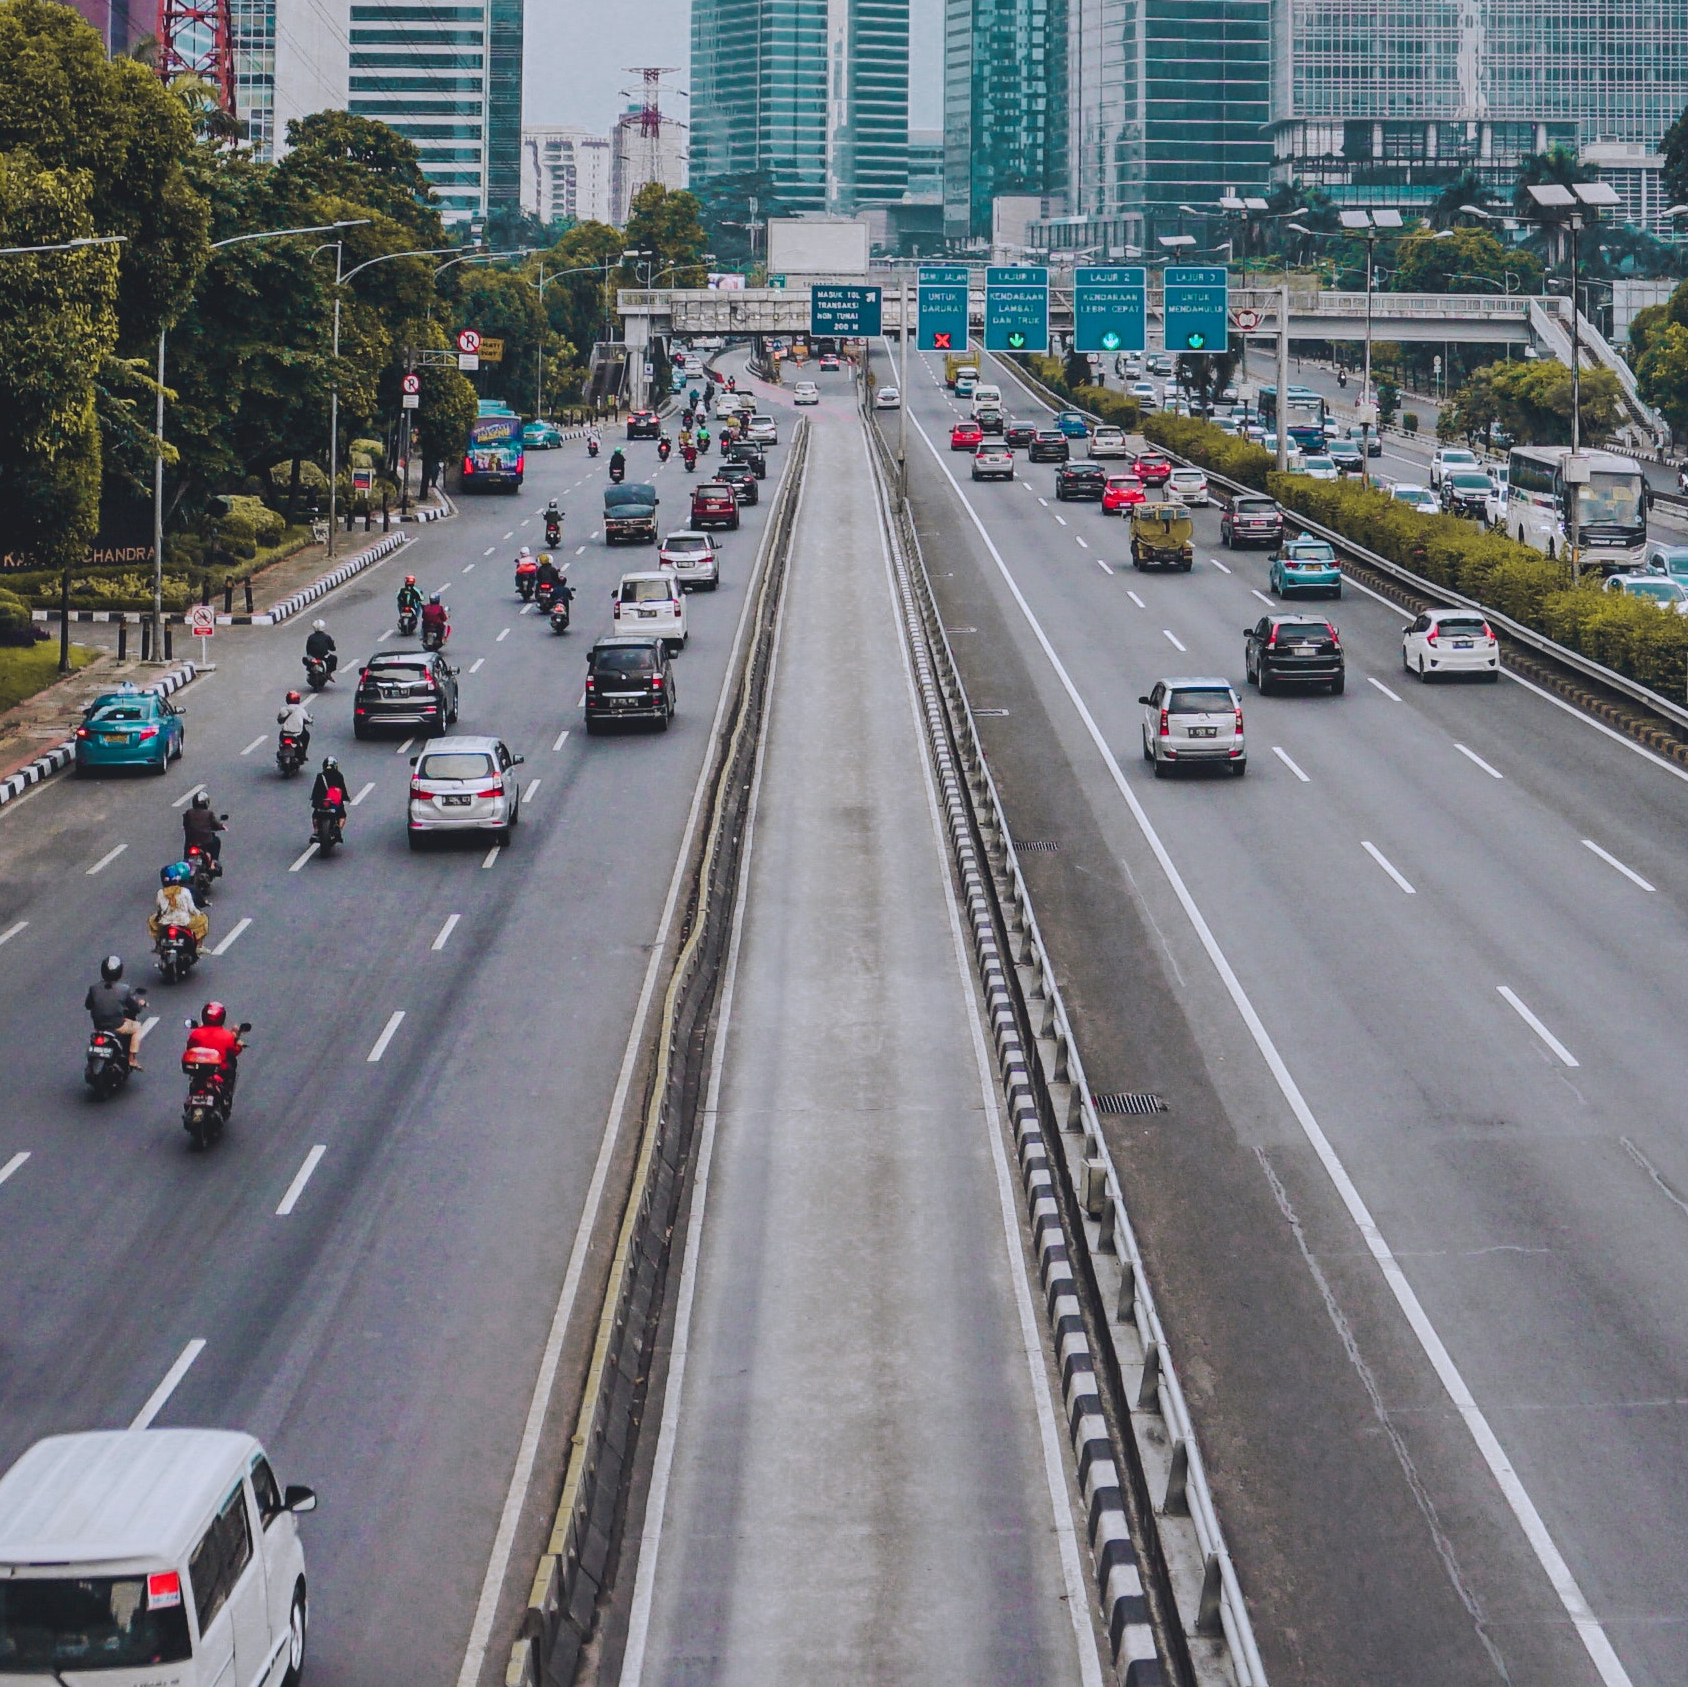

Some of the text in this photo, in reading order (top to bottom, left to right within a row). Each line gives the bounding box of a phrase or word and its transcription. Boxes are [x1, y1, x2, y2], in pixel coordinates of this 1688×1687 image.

[998, 272, 1027, 281] LAJUR
[1090, 273, 1130, 282] LAJUR 2
[1176, 273, 1204, 282] LAJUR
[817, 291, 843, 299] MASUK
[928, 293, 957, 301] UNTUK
[1083, 293, 1138, 301] KENDARAAN
[1182, 293, 1209, 301] UNTUK
[817, 301, 860, 309] TRANSAKSI
[1112, 305, 1139, 313] CEPAT
[992, 316, 1040, 324] DAN TRUK
[833, 322, 849, 331] 200
